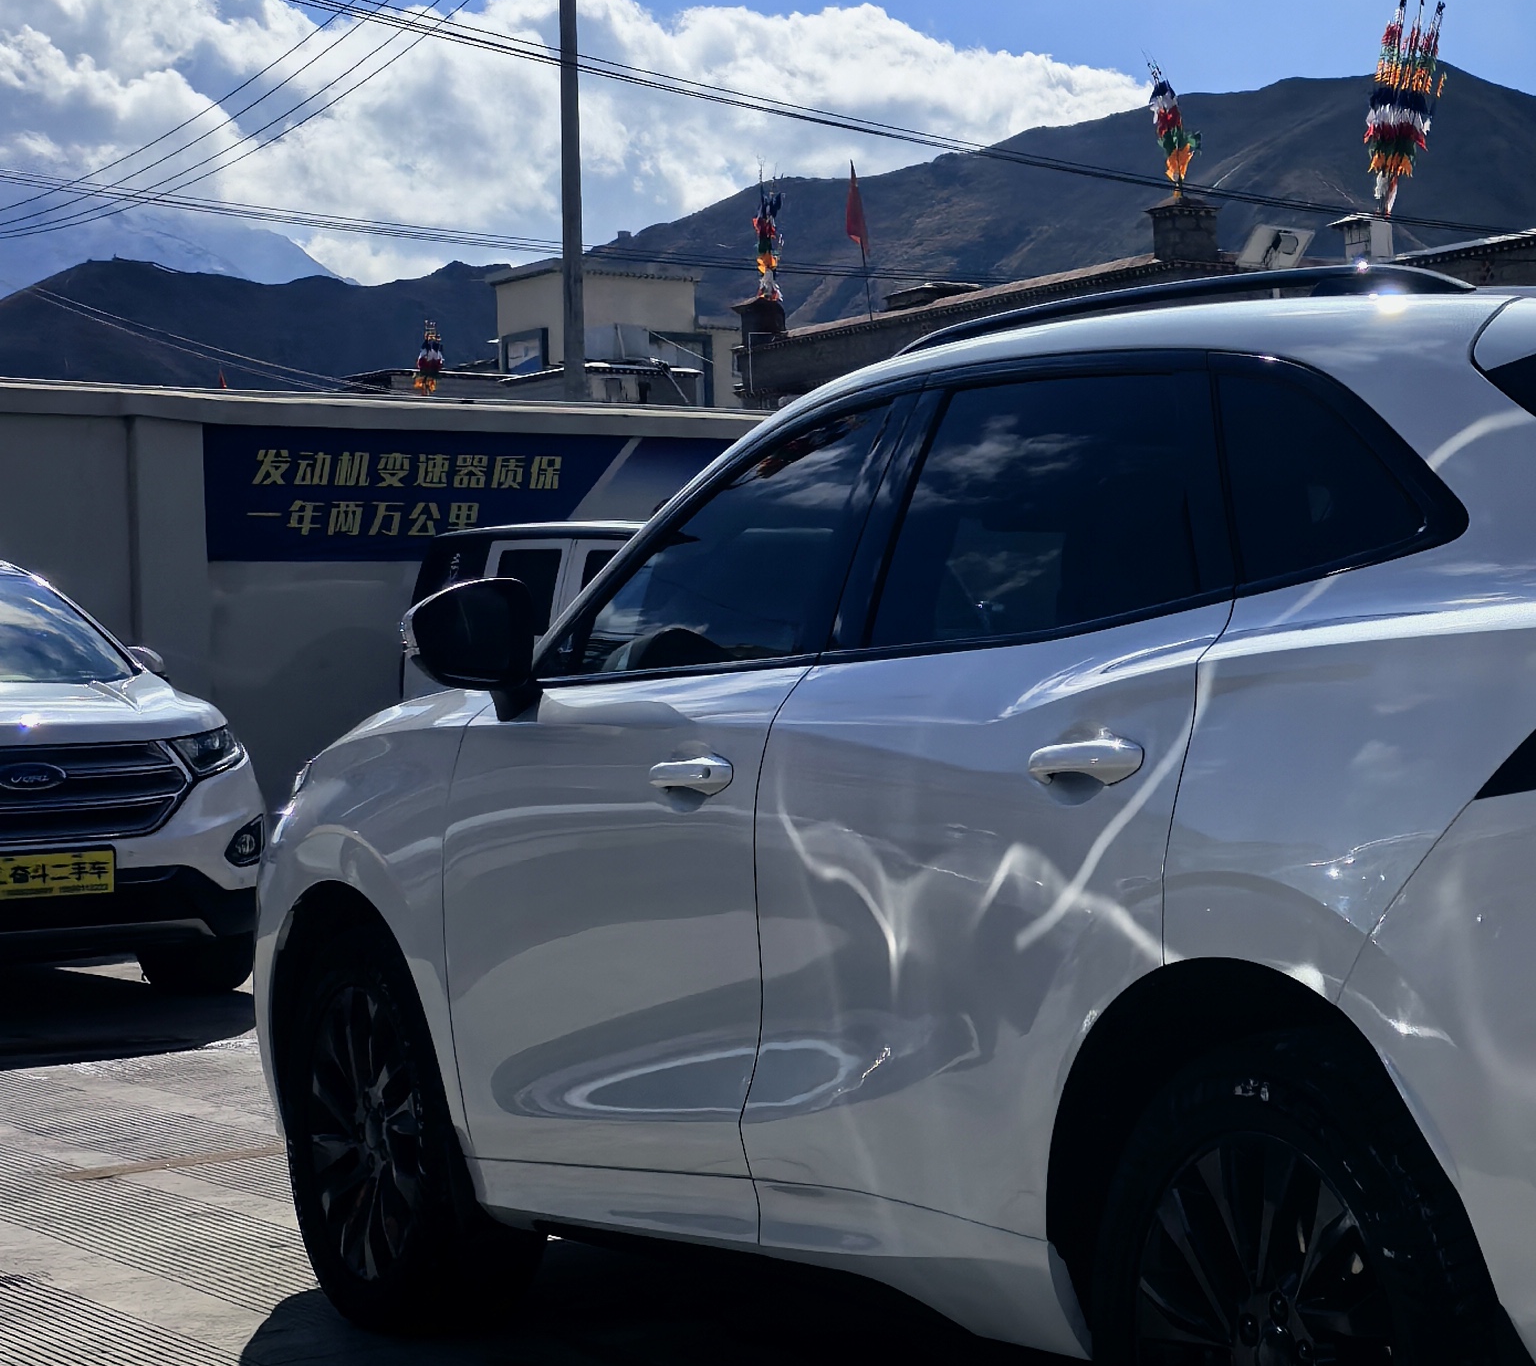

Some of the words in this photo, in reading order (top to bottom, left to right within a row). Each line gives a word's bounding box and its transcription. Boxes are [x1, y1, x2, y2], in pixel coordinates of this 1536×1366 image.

[252, 450, 562, 489] 发动机变速器质保
[247, 500, 479, 536] 一年两万公里
